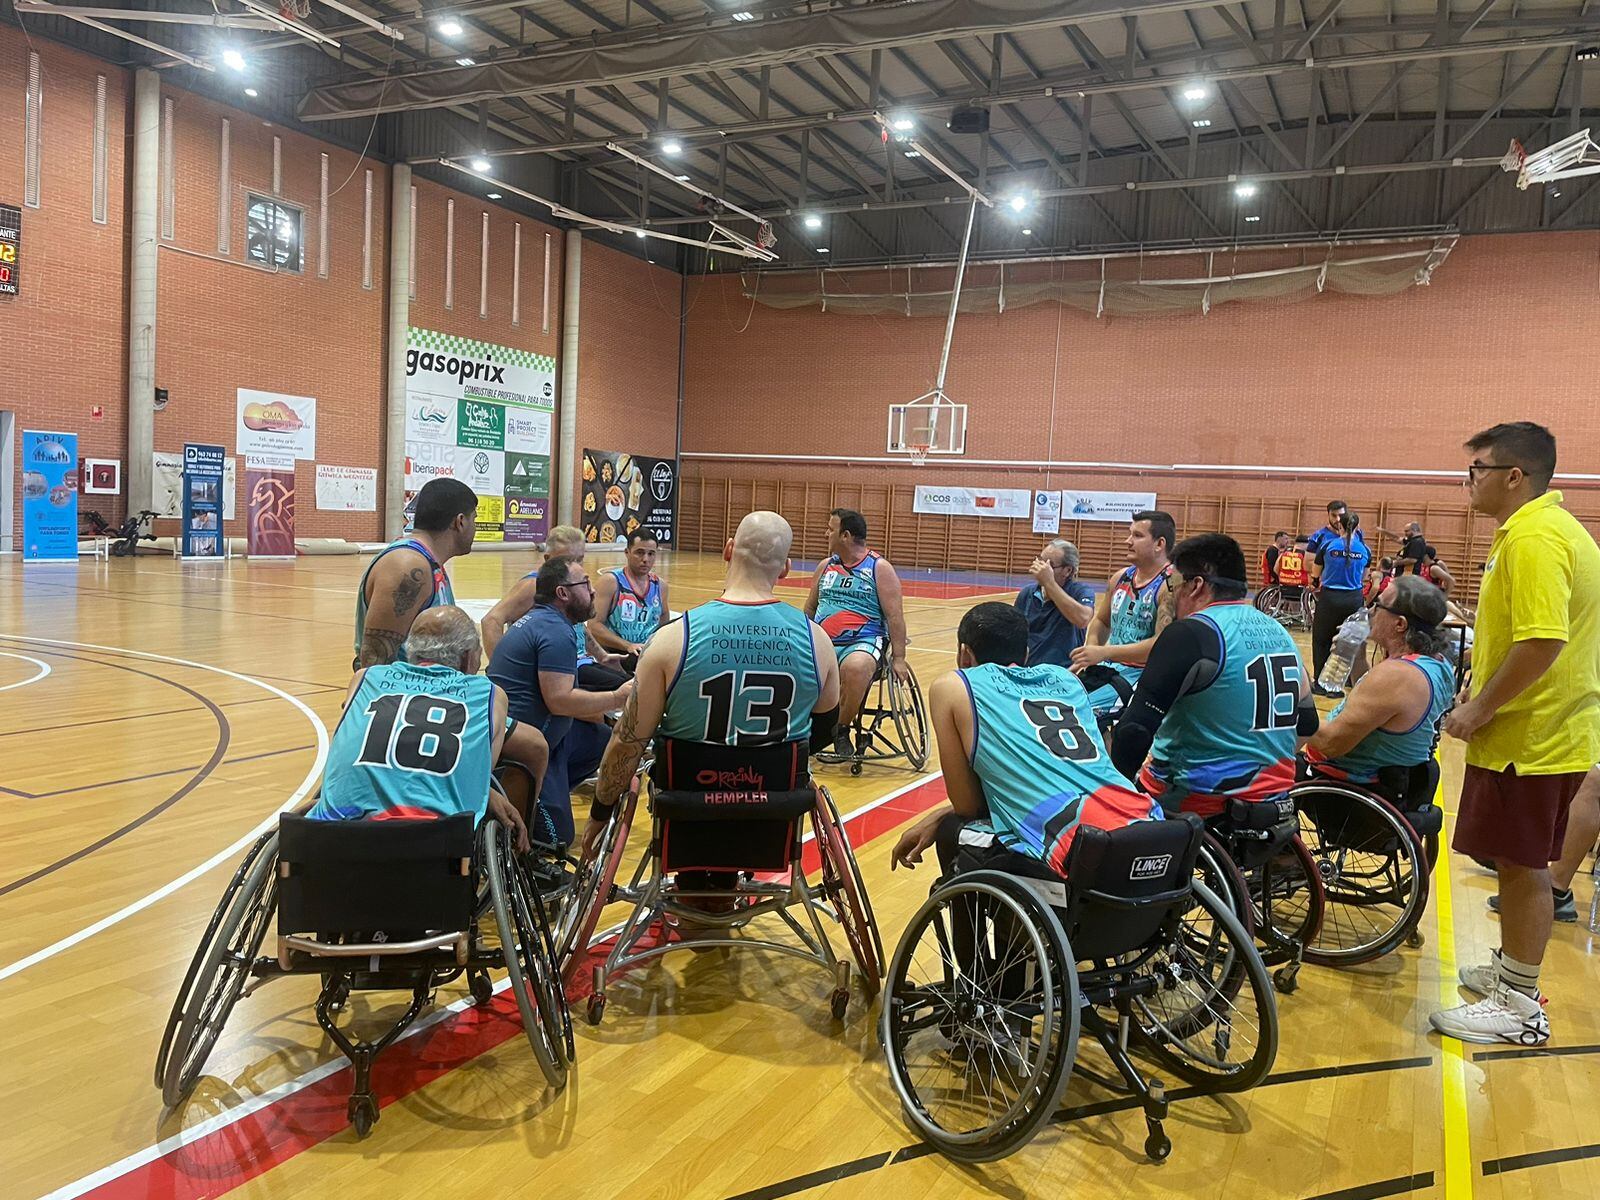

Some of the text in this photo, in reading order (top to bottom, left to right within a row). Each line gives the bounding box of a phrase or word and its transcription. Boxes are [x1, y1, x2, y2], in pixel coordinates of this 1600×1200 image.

[406, 349, 505, 385] gasoprix
[464, 385, 553, 407] COMBUSTIBLE PROFESIONAL PARA TODOS
[262, 411, 283, 420] OMA
[932, 495, 951, 503] COS
[839, 577, 853, 588] 16
[711, 624, 793, 638] UNIVERSITAT
[711, 637, 793, 652] POLITÈCNICA
[711, 652, 793, 667] DE VALÈNCIA
[379, 680, 399, 691] DE
[1245, 652, 1301, 733] 15
[699, 670, 797, 747] 13
[352, 693, 470, 778] 18
[1019, 697, 1101, 764] 8
[704, 791, 769, 805] HEMPLER
[1135, 858, 1167, 872] LINCE
